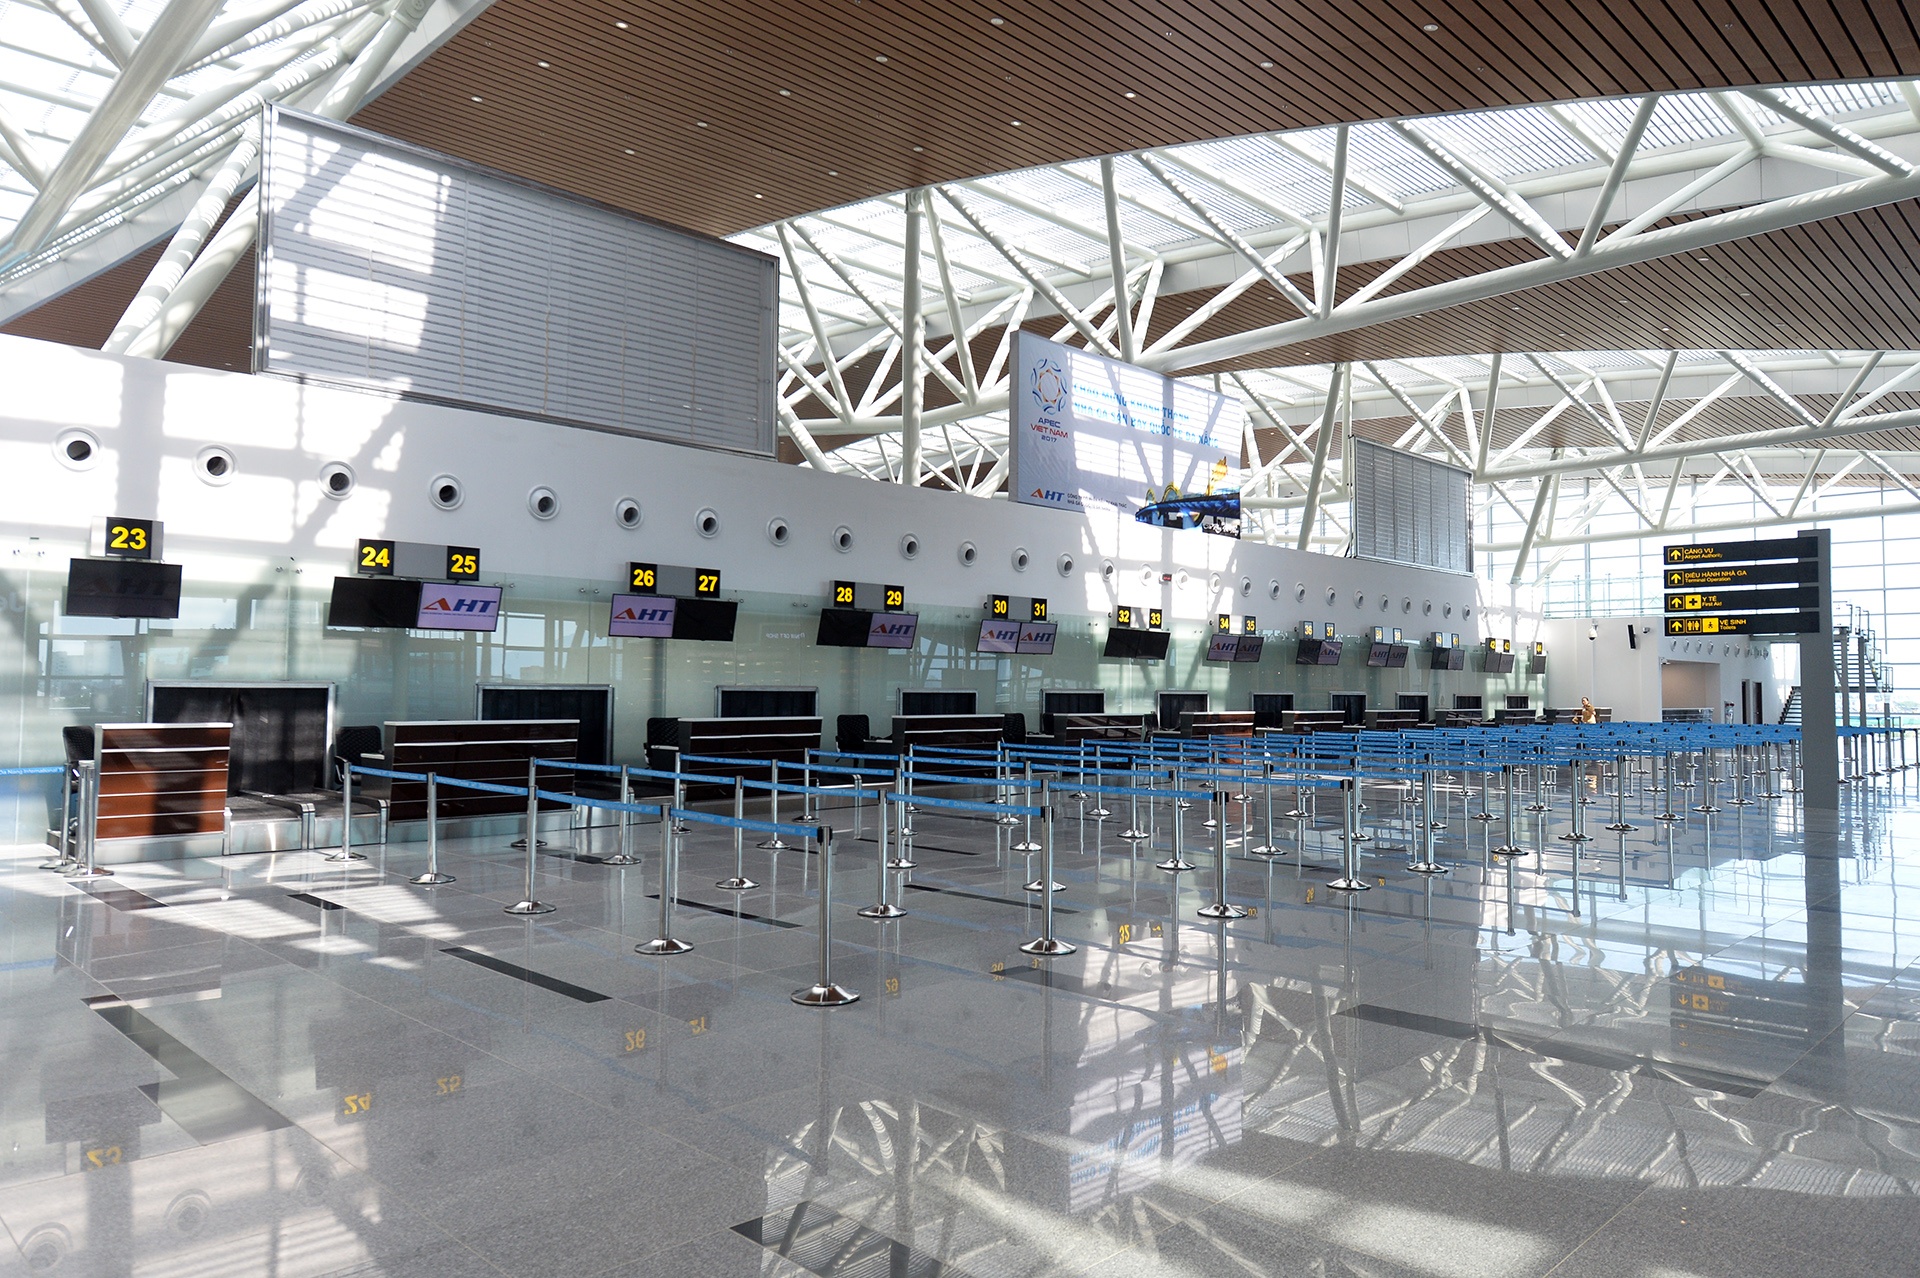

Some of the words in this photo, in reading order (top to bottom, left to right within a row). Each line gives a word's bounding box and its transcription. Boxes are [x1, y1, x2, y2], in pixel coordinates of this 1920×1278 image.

[1038, 417, 1060, 428] APEC
[1042, 434, 1062, 442] 2017
[1054, 428, 1068, 438] NAM
[1030, 488, 1064, 502] AHT
[110, 526, 146, 550] 23
[361, 546, 390, 568] 24
[450, 554, 476, 574] 25
[633, 569, 654, 586] 26
[698, 575, 718, 592] 27
[836, 587, 852, 602] 28
[886, 590, 902, 606] 29
[424, 598, 496, 612] AHT
[994, 600, 1006, 614] 30
[1034, 603, 1046, 616] 31
[614, 608, 672, 622] AHT
[1118, 610, 1130, 622] 32
[1150, 612, 1160, 625] 33
[871, 624, 914, 634] AHT
[1220, 618, 1229, 629] 34
[1246, 620, 1254, 631] 35
[981, 630, 1018, 640] AHT
[1020, 632, 1054, 642] AHT
[1304, 625, 1312, 636] 36
[1326, 627, 1334, 636] 37
[1211, 642, 1236, 650] AHT
